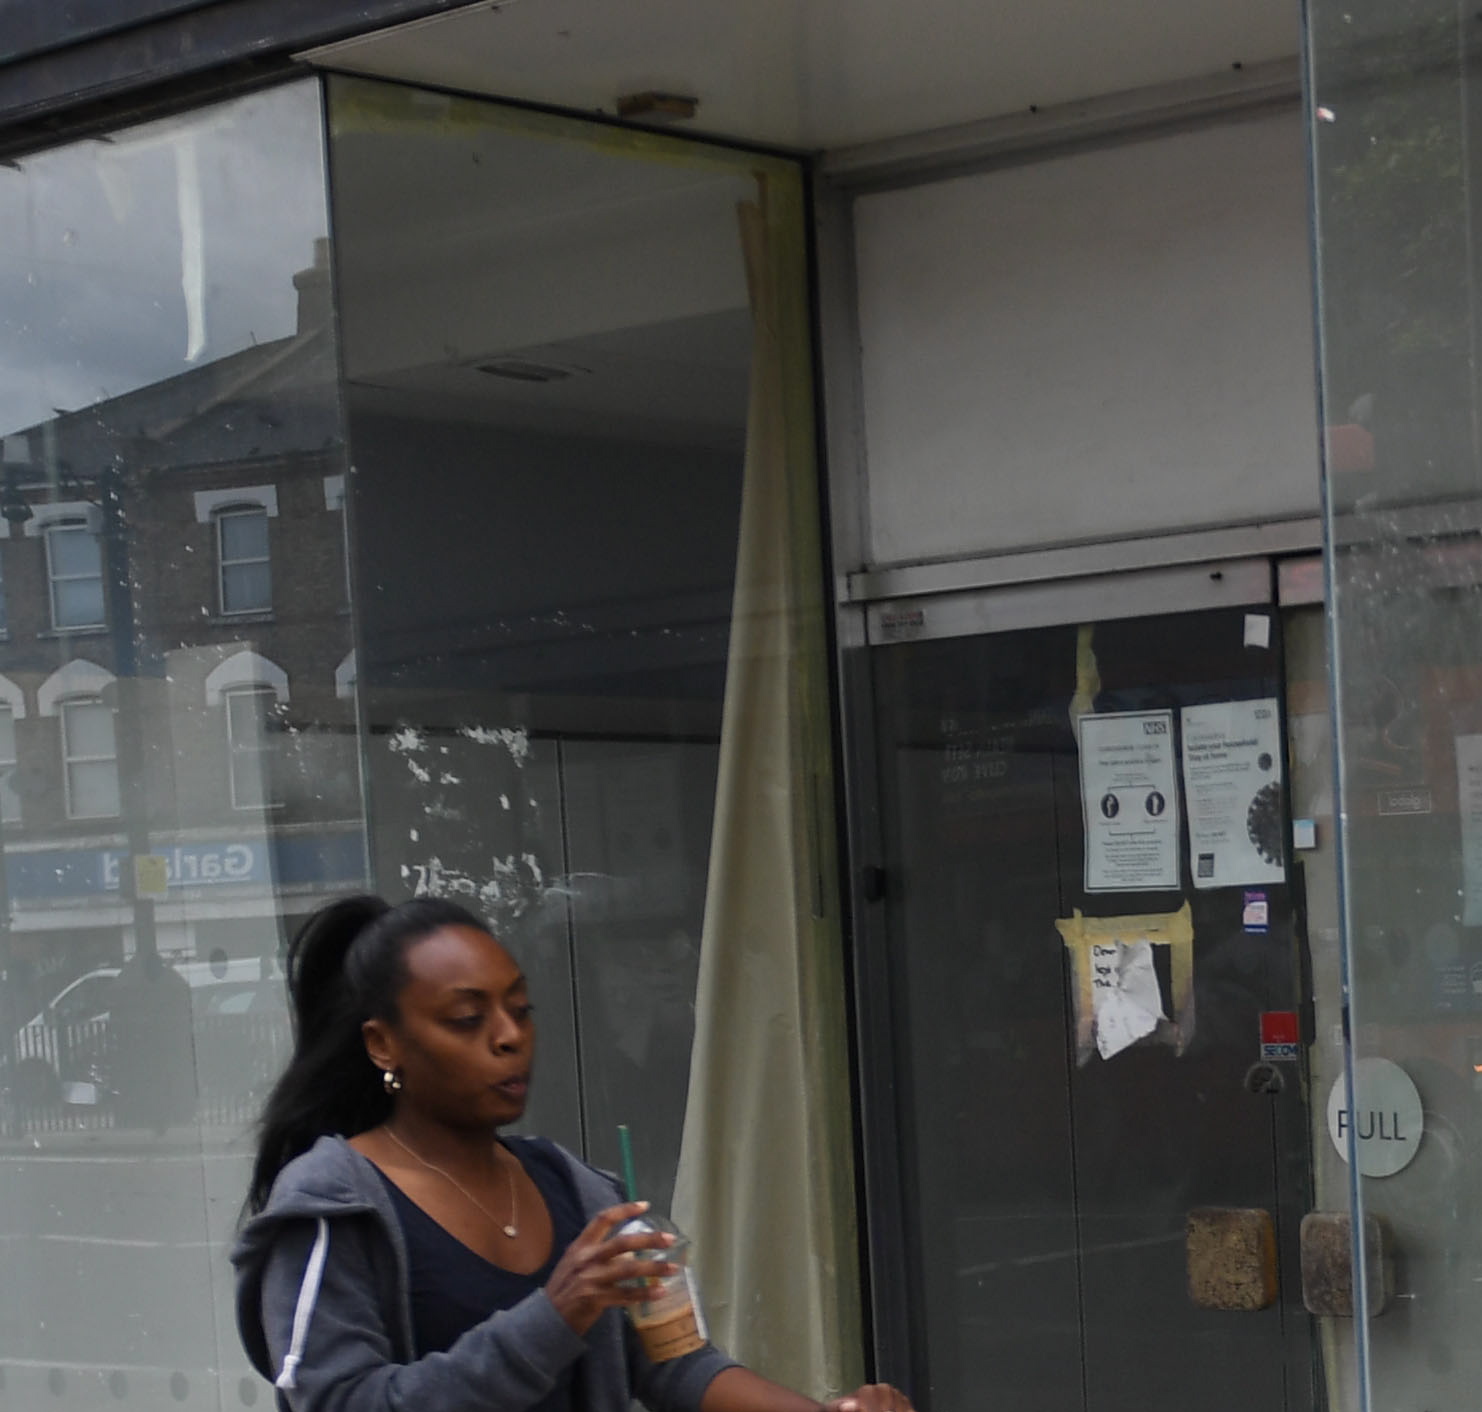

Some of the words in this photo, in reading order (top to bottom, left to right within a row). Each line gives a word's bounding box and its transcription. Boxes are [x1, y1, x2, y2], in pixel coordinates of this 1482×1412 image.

[1142, 721, 1167, 735] NHS
[1264, 1045, 1298, 1056] SECOM
[1338, 1110, 1407, 1141] PULL
